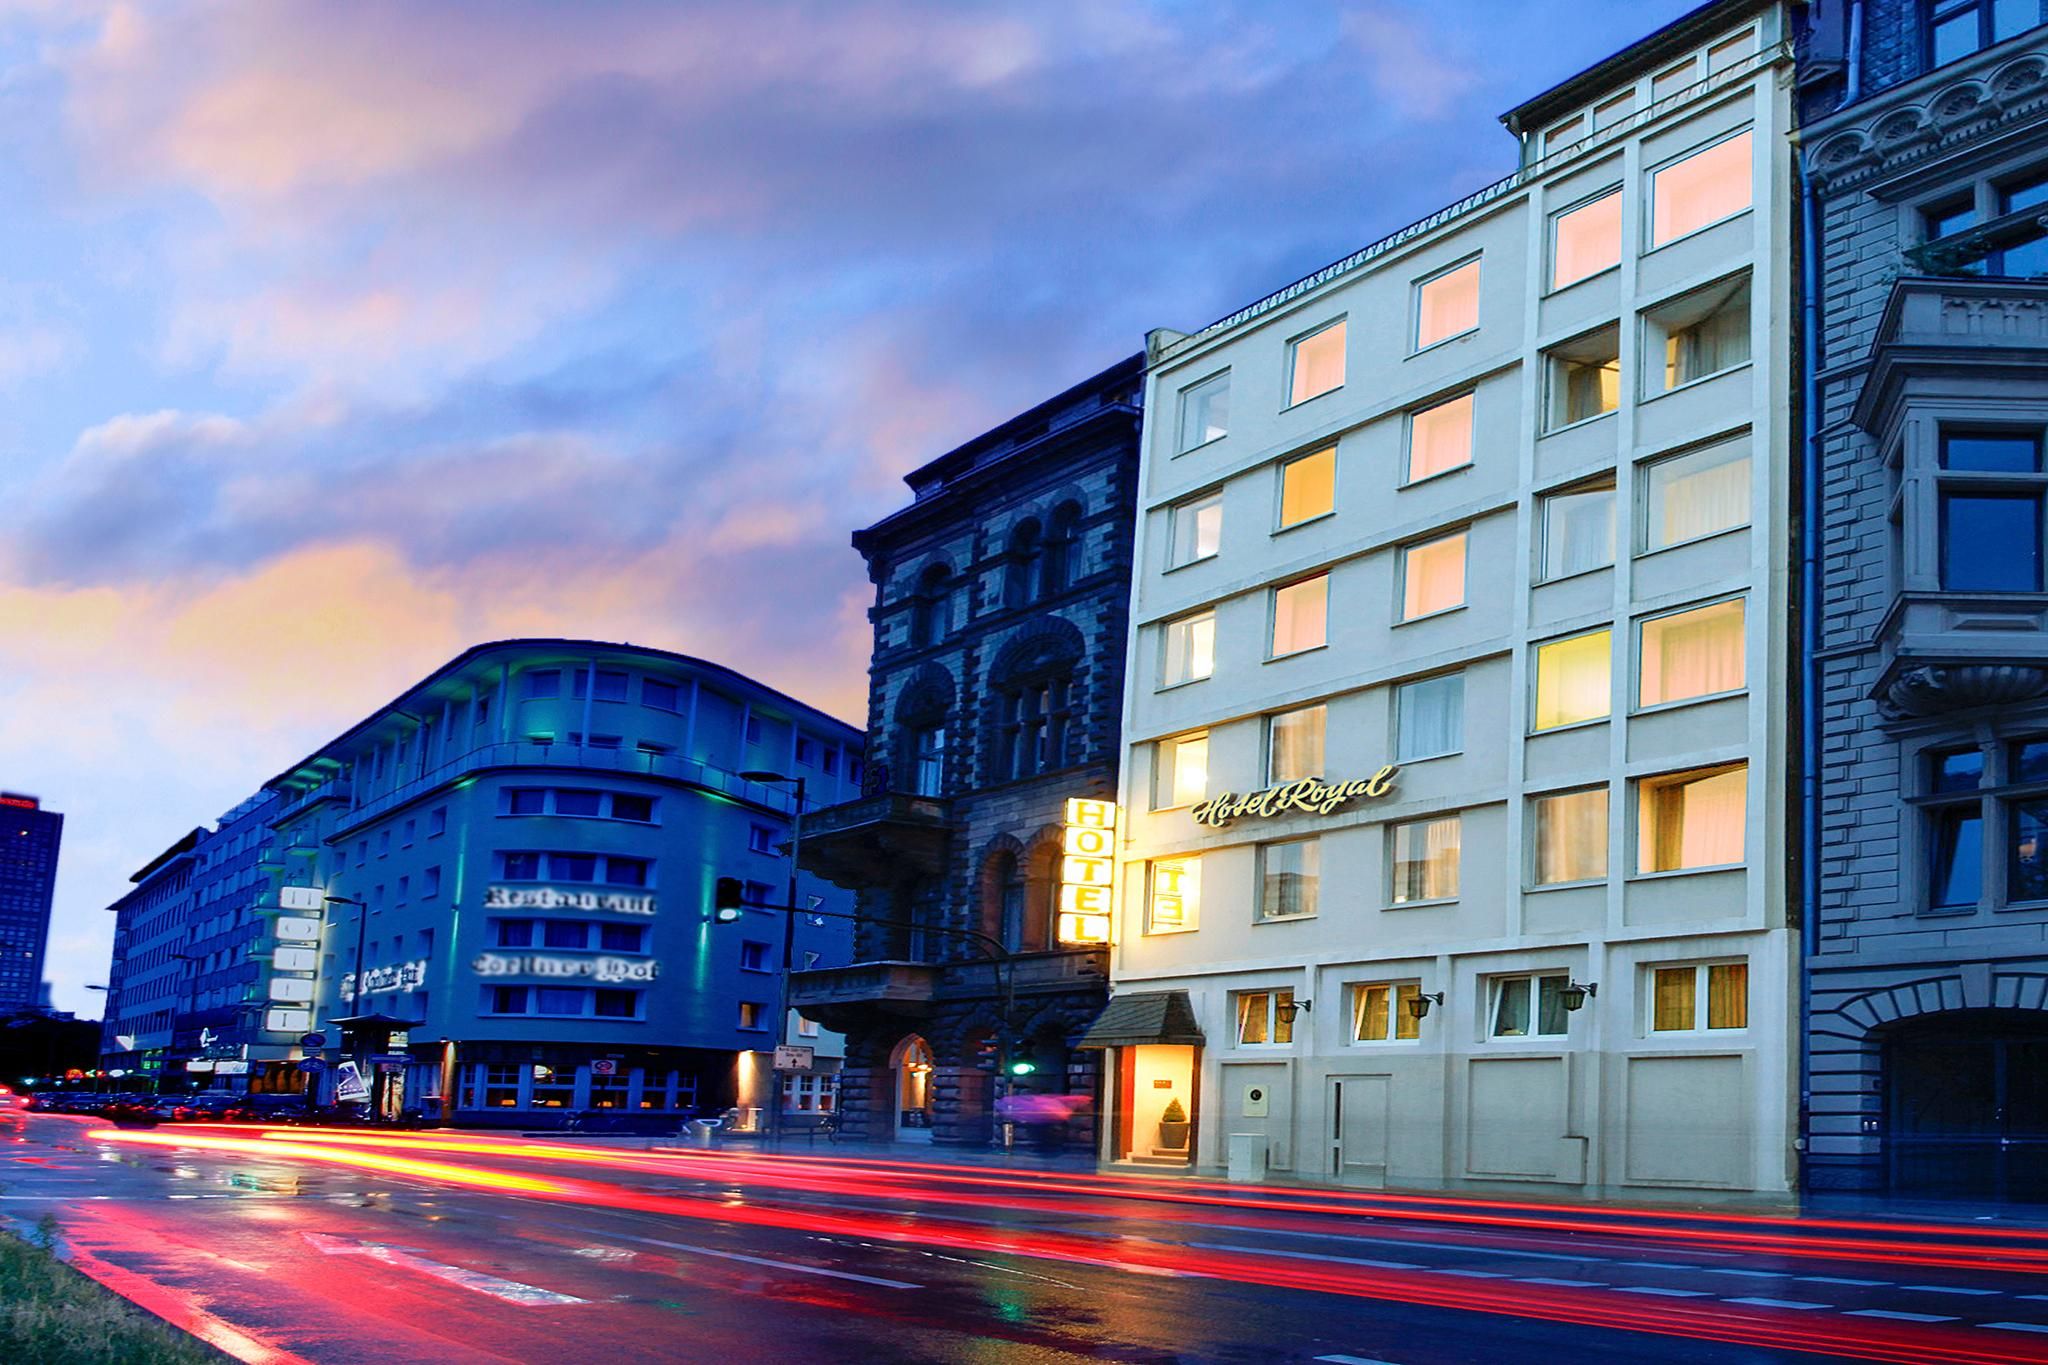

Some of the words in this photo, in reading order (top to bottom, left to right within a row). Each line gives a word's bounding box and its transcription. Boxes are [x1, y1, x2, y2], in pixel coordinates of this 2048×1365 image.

[1276, 764, 1395, 815] Royal
[1072, 801, 1106, 941] HOTEL
[485, 886, 657, 915] Restaurant
